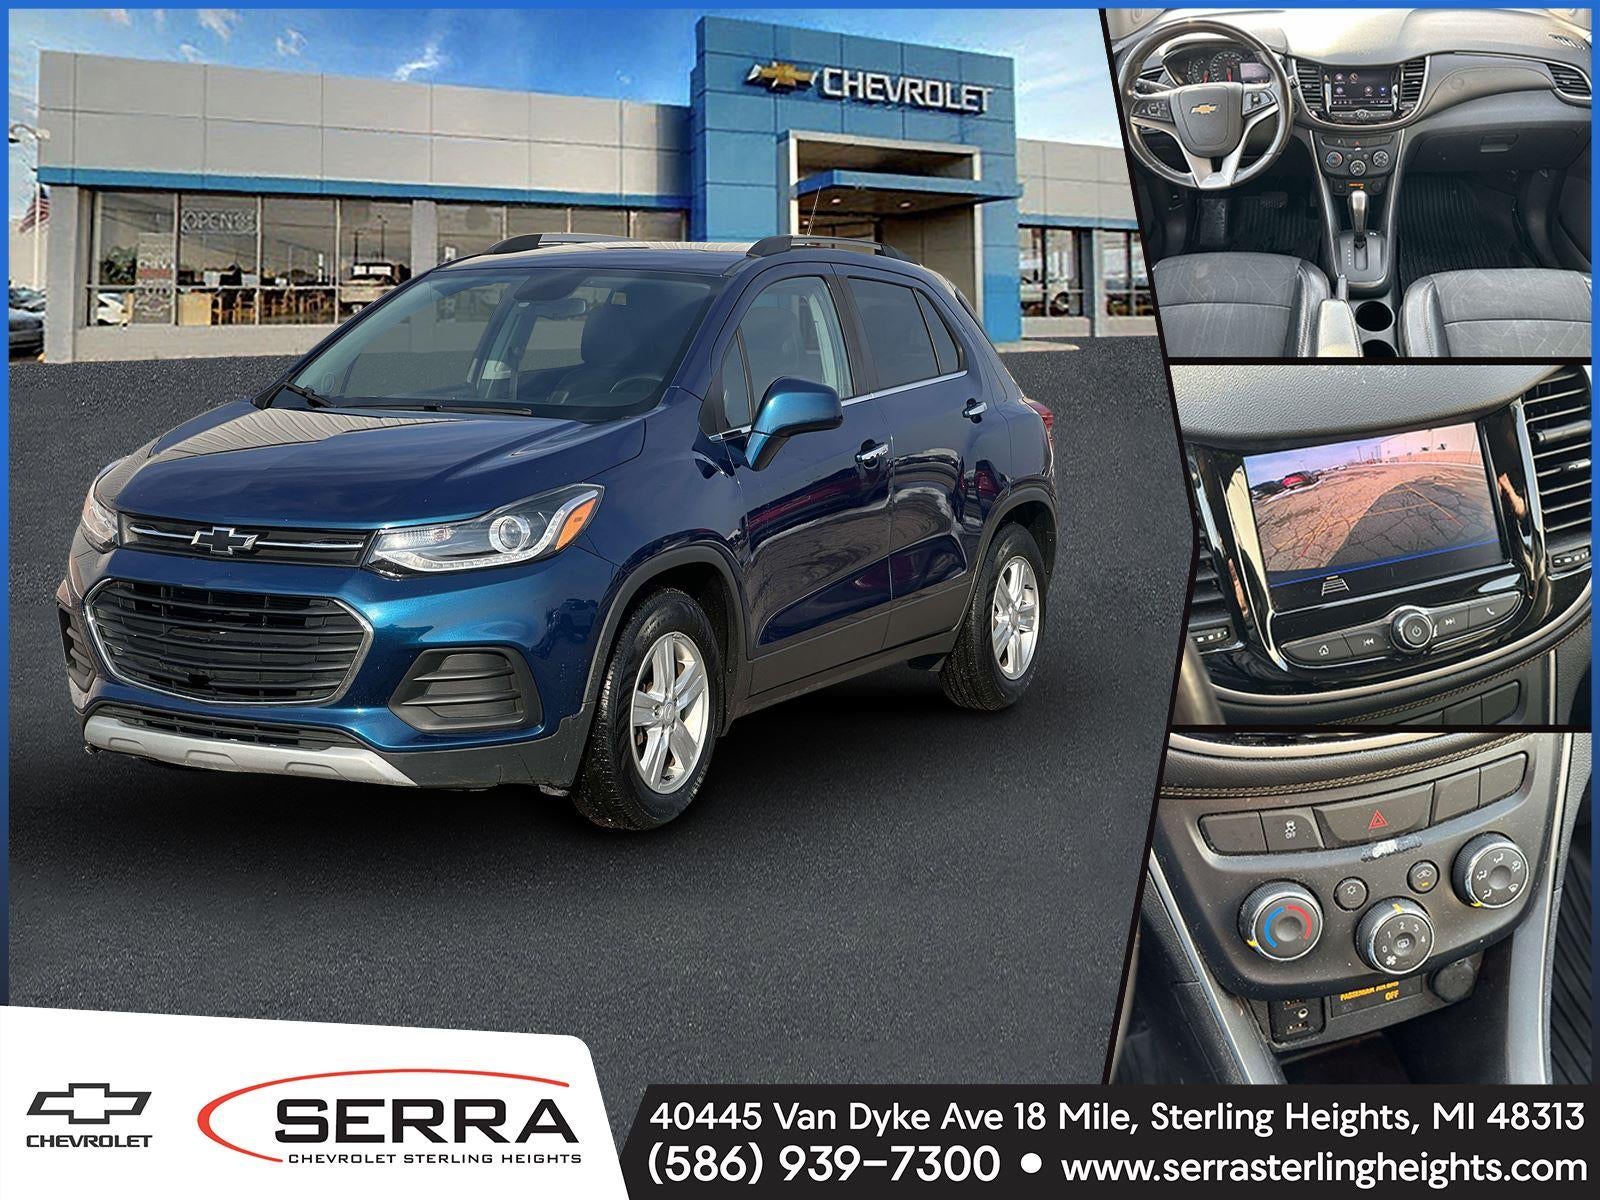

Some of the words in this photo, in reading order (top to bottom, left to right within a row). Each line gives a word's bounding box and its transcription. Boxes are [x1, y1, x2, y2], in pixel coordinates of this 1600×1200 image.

[822, 66, 993, 112] CHEVROLET
[1399, 921, 1405, 930] 2
[1414, 924, 1420, 932] 3
[1384, 989, 1399, 1001] OFF
